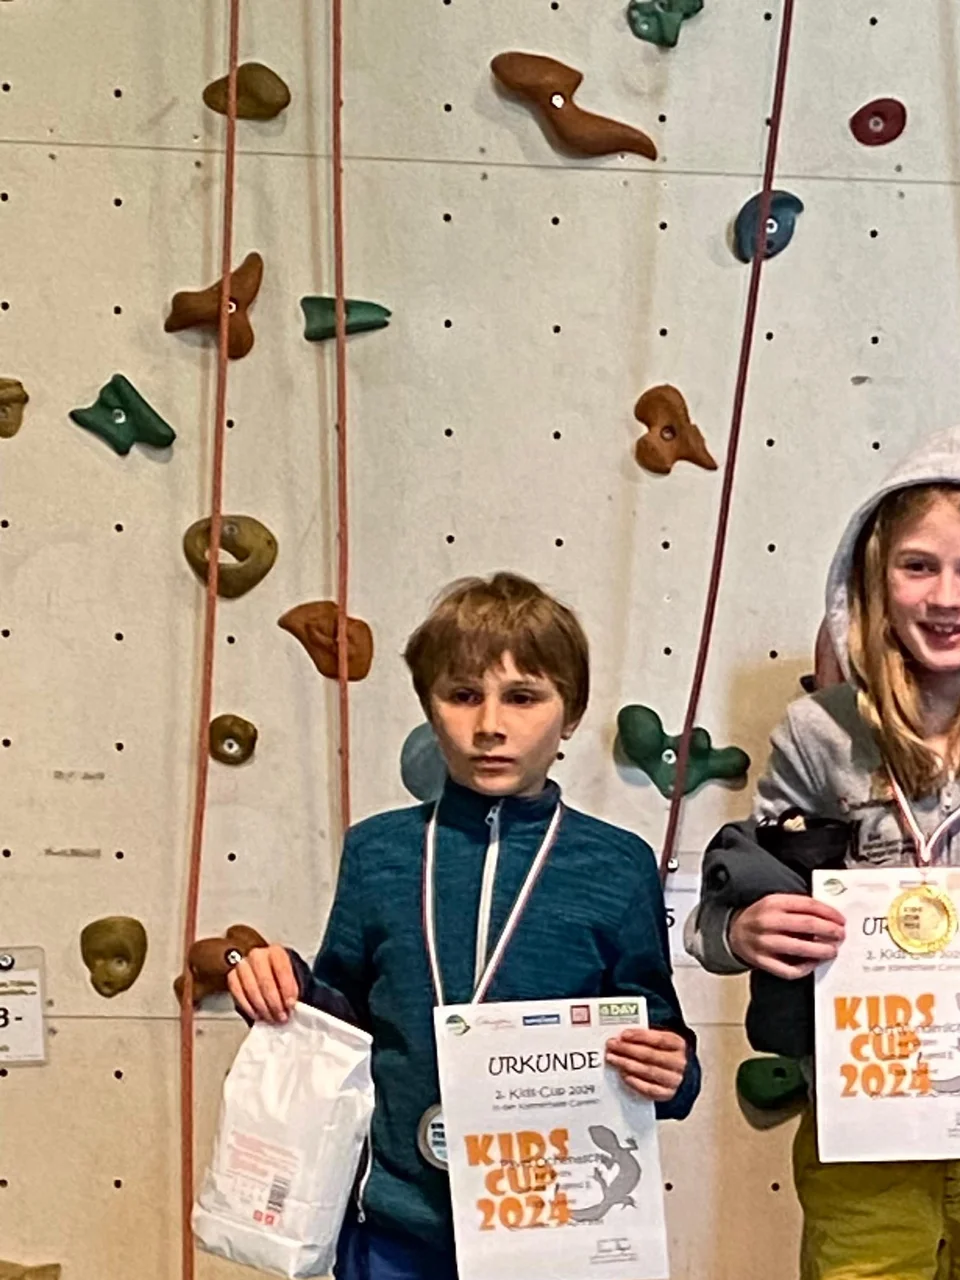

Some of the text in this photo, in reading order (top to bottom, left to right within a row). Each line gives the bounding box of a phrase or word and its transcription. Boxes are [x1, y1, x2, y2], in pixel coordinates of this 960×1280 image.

[834, 992, 936, 1031] KIDS
[489, 1051, 600, 1075] URKUNDE
[850, 1031, 921, 1062] CUP
[839, 1062, 933, 1098] 2024
[464, 1128, 570, 1167] KIDS
[484, 1165, 558, 1197] CUP
[476, 1193, 573, 1231] 2024
